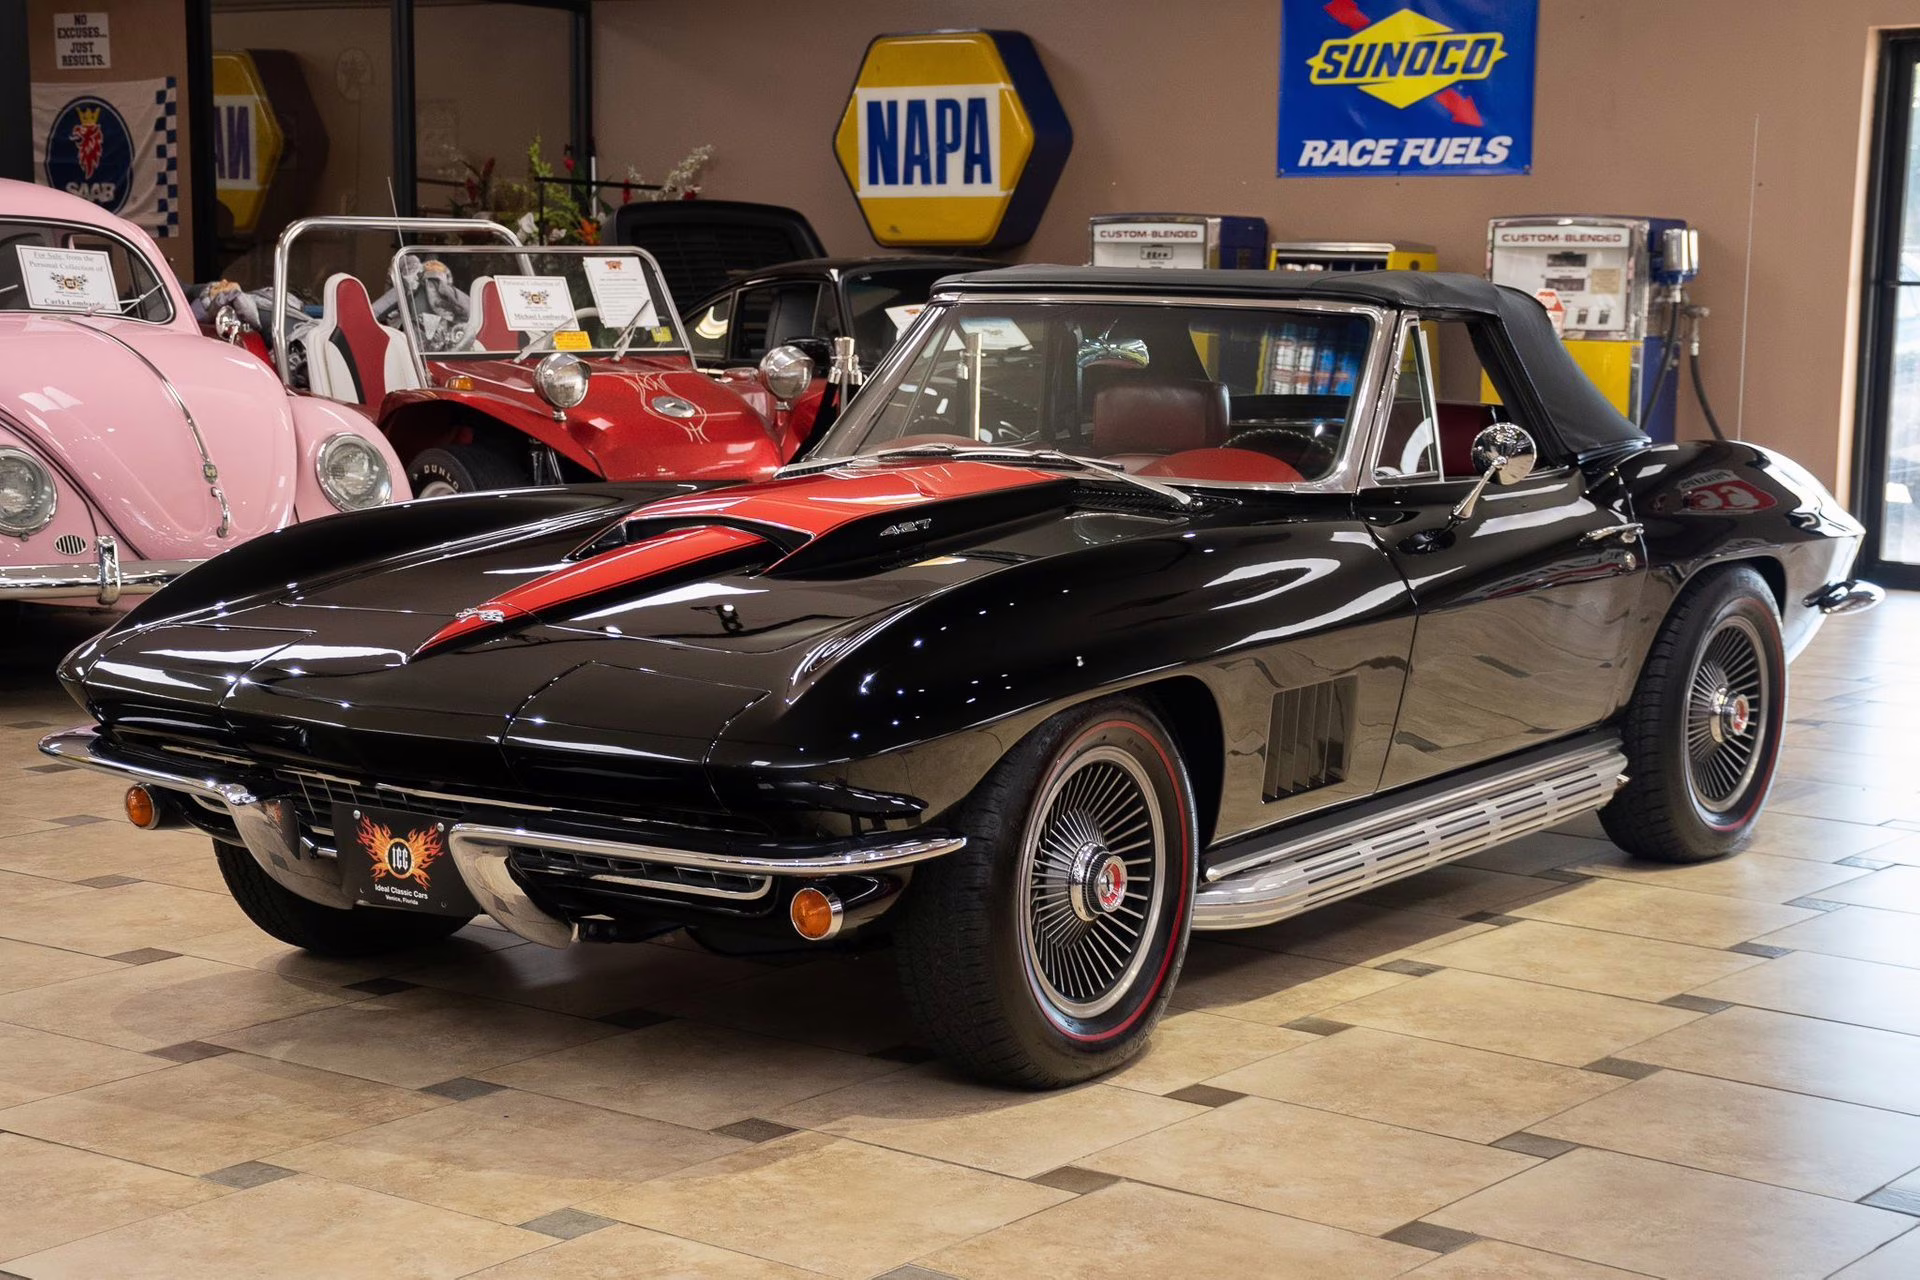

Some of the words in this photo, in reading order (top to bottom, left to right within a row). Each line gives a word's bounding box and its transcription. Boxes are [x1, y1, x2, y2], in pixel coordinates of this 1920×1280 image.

[74, 14, 87, 26] NO
[70, 42, 94, 53] JUST
[1317, 38, 1497, 80] SUNOCO
[867, 97, 992, 186] NAPA
[1298, 138, 1399, 167] RACE
[1398, 136, 1514, 166] FUELS
[65, 182, 116, 202] SAAB
[424, 464, 459, 490] DUNLO
[880, 518, 932, 537] 427
[392, 847, 408, 870] ICC
[374, 883, 390, 893] Ideal
[390, 886, 413, 897] Classic
[413, 890, 429, 900] Cars
[402, 897, 419, 906] Florida
